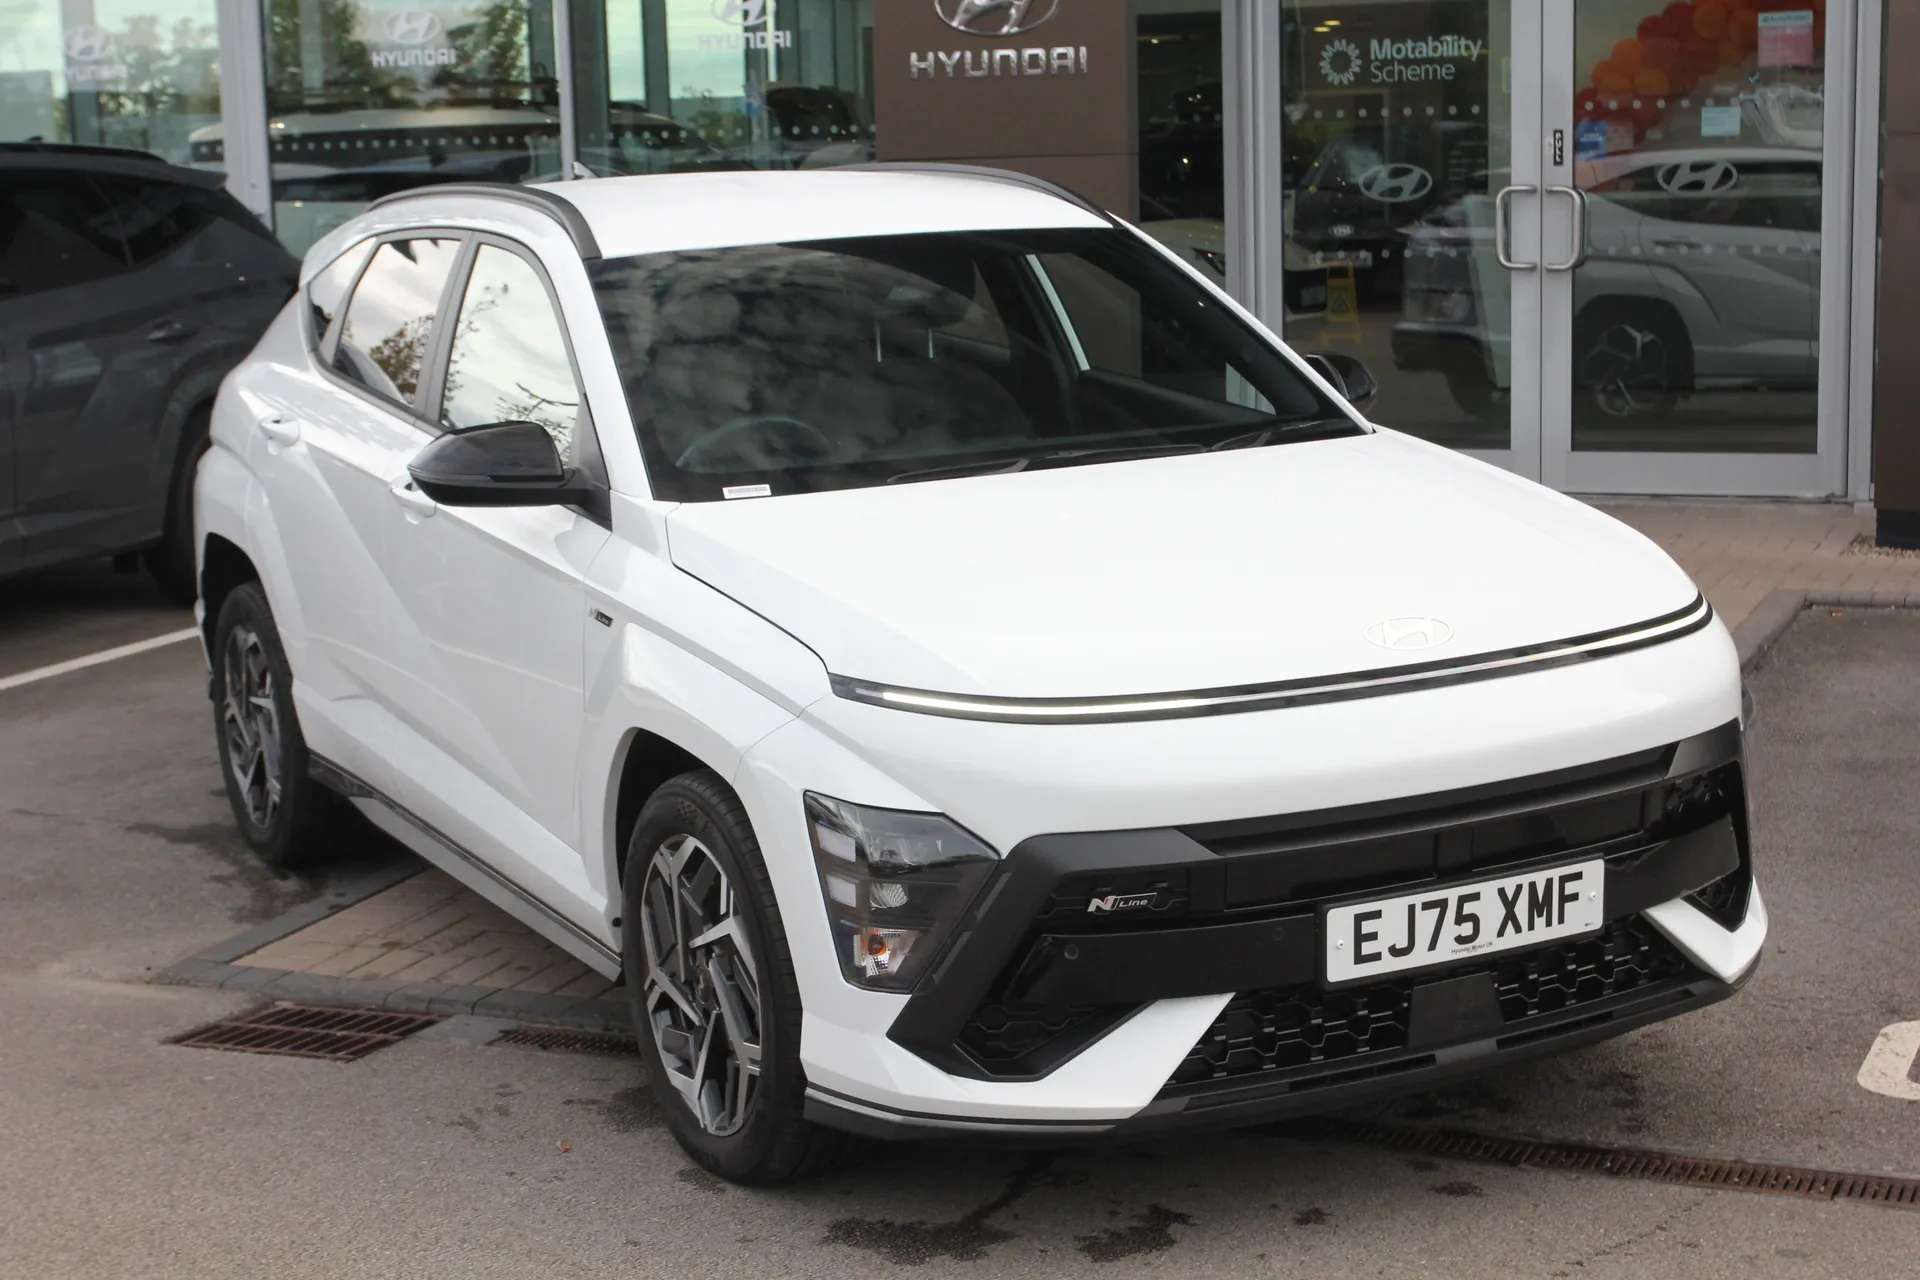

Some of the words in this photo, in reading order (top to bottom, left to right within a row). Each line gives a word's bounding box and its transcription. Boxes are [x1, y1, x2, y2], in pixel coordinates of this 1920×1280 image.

[372, 48, 457, 68] HYUNDAI
[1370, 35, 1482, 61] Motability
[909, 46, 1088, 79] HYUNDAI
[1370, 61, 1456, 83] Scheme
[1119, 899, 1148, 908] Line
[1353, 891, 1481, 965] EJ75
[1496, 871, 1583, 938] XMF
